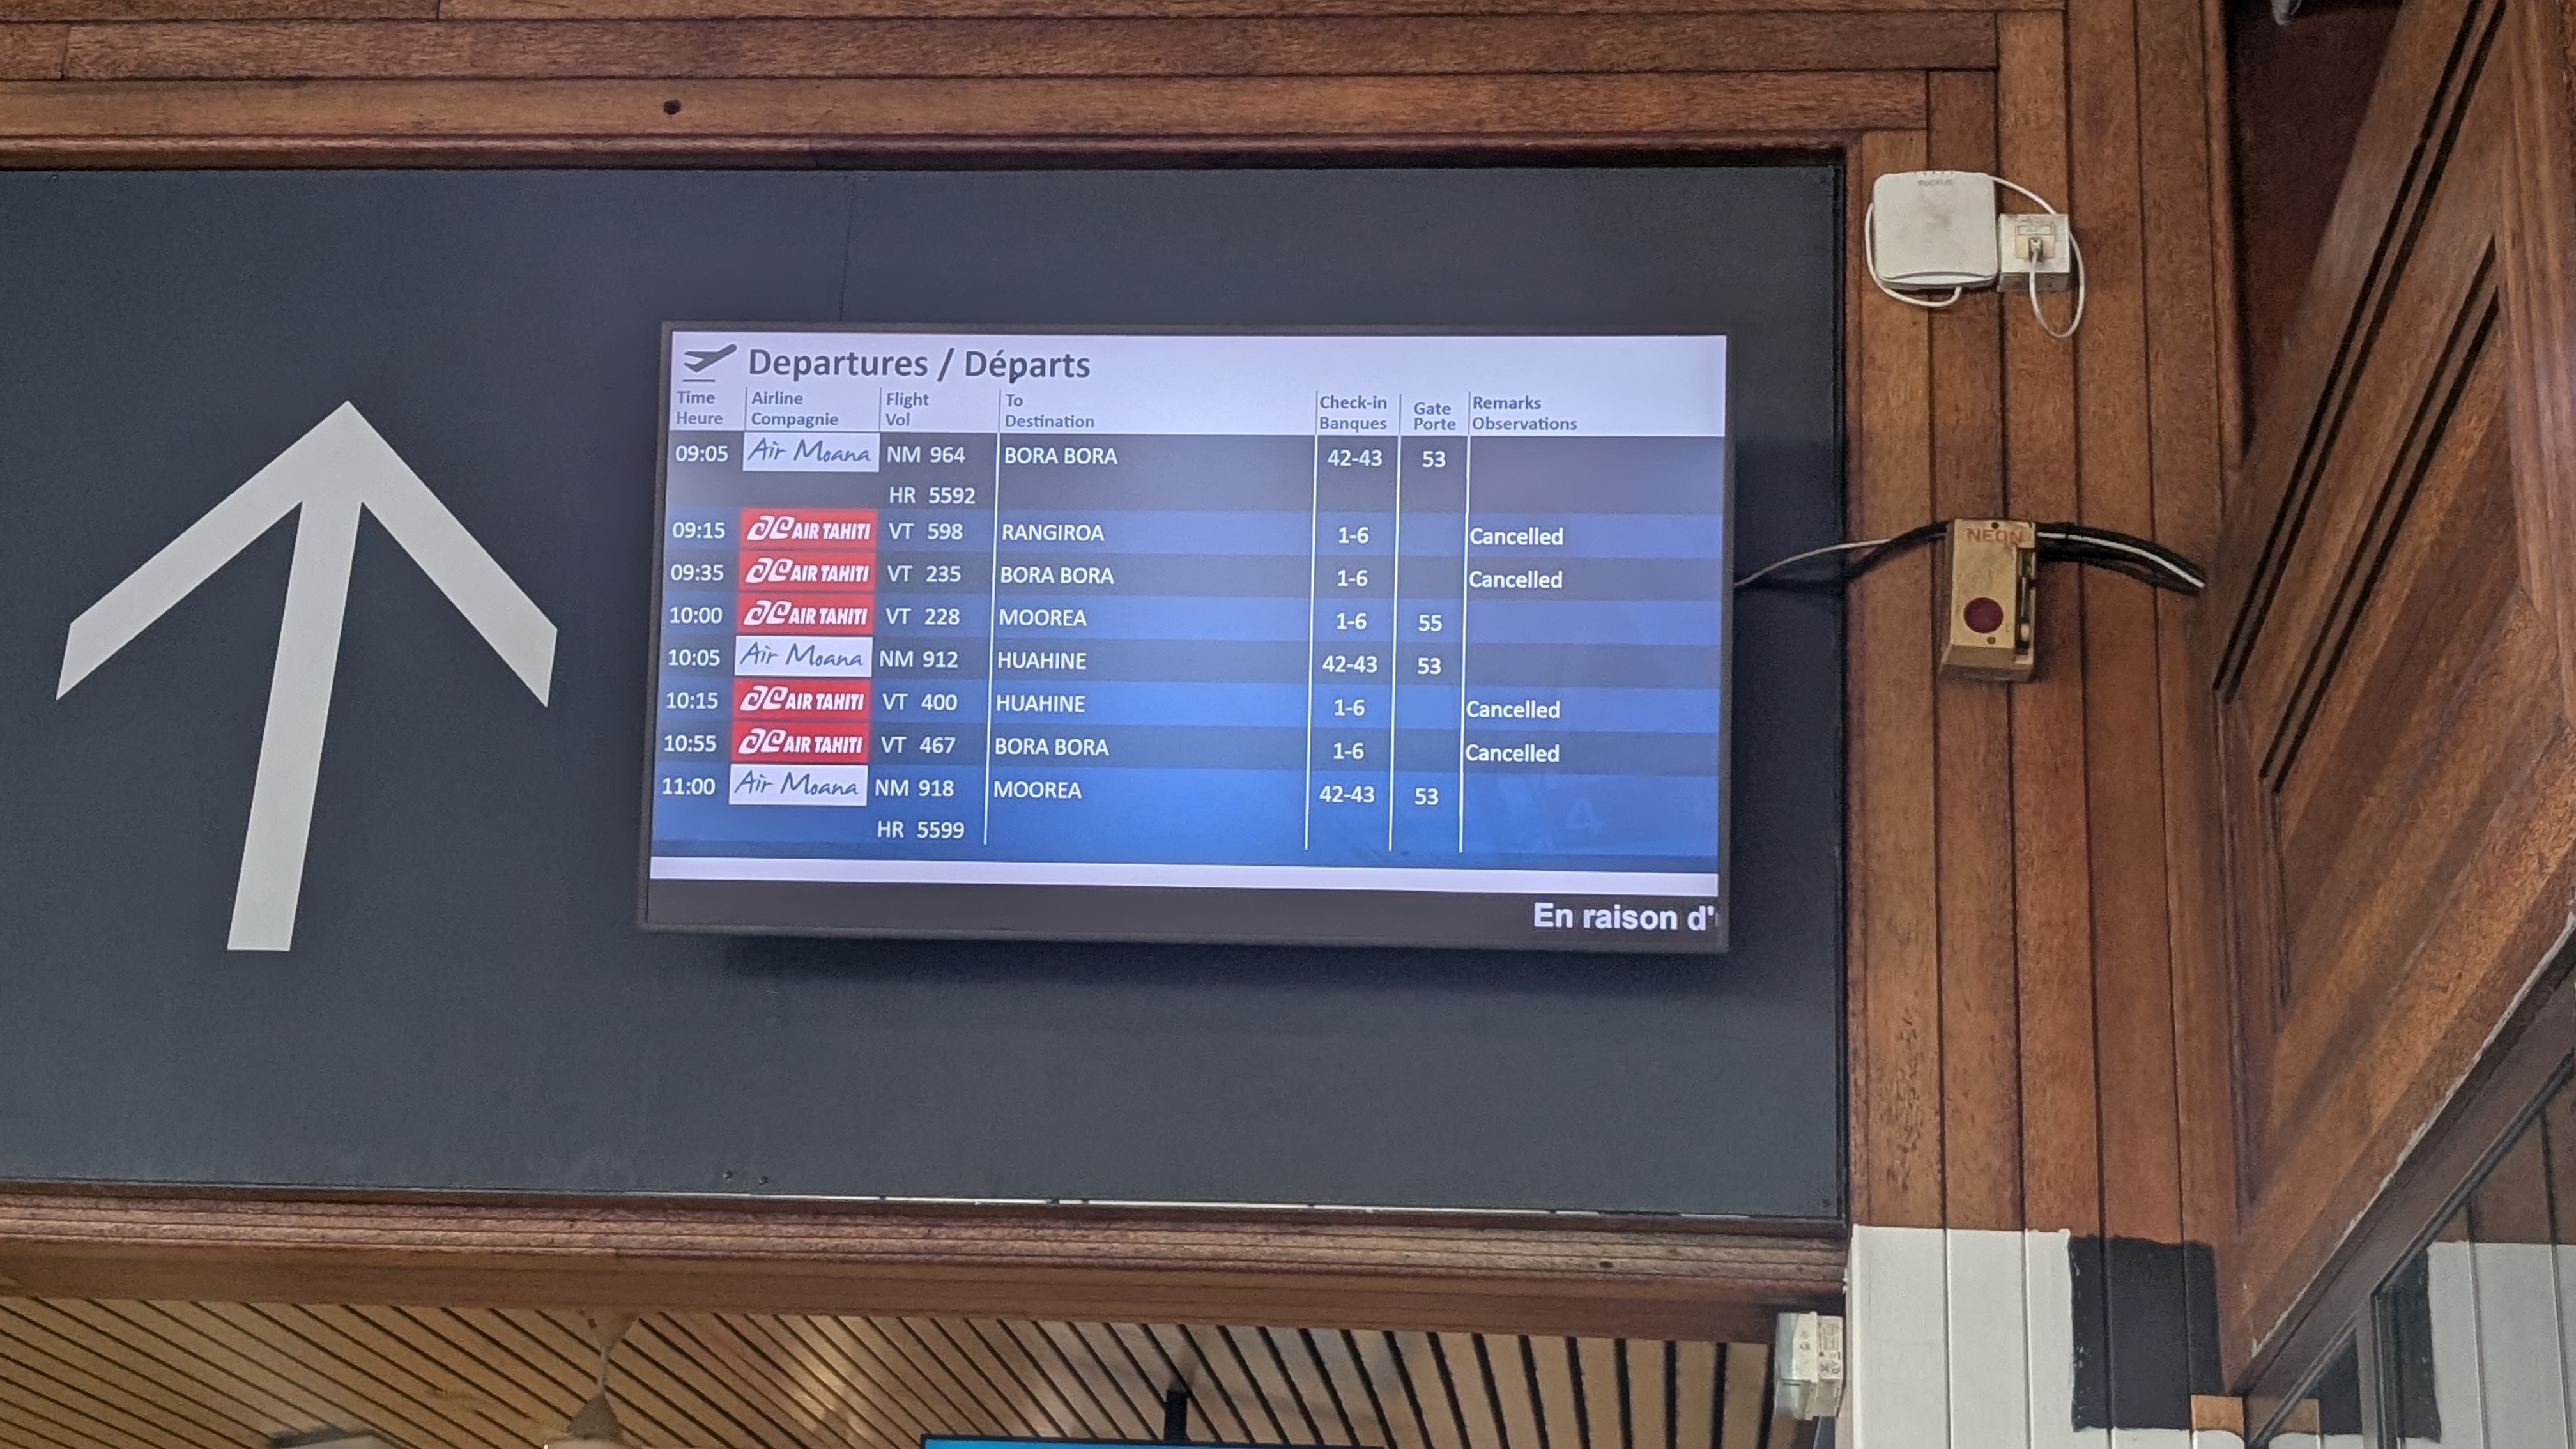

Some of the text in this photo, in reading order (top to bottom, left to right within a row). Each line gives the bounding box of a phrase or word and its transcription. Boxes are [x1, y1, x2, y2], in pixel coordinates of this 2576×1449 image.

[750, 348, 1089, 383] Departures / Départs
[677, 391, 715, 404] Time
[752, 391, 802, 404] Airline
[887, 392, 928, 408] Flight
[1006, 394, 1023, 406] To
[1320, 395, 1386, 409] Check-in
[1474, 395, 1541, 409] Remarks
[1414, 402, 1451, 415] Gate
[677, 411, 723, 424] Heure
[752, 413, 838, 428] Compagnie
[886, 413, 910, 425] Vol
[1006, 415, 1094, 427] Destination
[1320, 417, 1386, 433] Banques
[1414, 418, 1456, 430] Porte
[1473, 417, 1577, 430] Observations
[676, 446, 728, 461] 09:05
[748, 438, 870, 462] Air Moana
[887, 446, 965, 463] NM 964
[1006, 447, 1117, 464] BORA BORA
[1328, 450, 1382, 466] 42-43
[1423, 451, 1445, 467] 53
[890, 487, 975, 504] HR 5592
[673, 522, 724, 538] 09:15
[792, 523, 870, 539] AIR TAHITI
[889, 523, 962, 539] VT 598
[1003, 525, 1104, 541] RANGIROA
[1339, 527, 1368, 543] 1-6
[1470, 528, 1563, 545] Cancelled
[1966, 528, 2024, 544] NEON
[671, 564, 723, 581] 09:35
[790, 565, 869, 581] AIR TAHITI
[887, 565, 960, 582] VT 235
[1001, 567, 1114, 584] BORA BORA
[1338, 570, 1367, 586] 1-6
[1469, 571, 1562, 588] Cancelled
[671, 607, 722, 623] 10:00
[788, 608, 867, 624] AIR TAHITI
[886, 608, 960, 625] VT 228
[1000, 610, 1087, 626] MOOREA
[1337, 613, 1367, 629] 1-6
[1419, 615, 1442, 631] 55
[669, 650, 719, 666] 10:05
[740, 642, 862, 666] Air Moana
[880, 650, 958, 668] NM 912
[999, 652, 1086, 669] HUAHINE
[1322, 656, 1377, 673] 42-43
[1418, 658, 1441, 674] 53
[667, 693, 717, 709] 10:15
[785, 693, 864, 710] AIR TAHITI
[883, 694, 957, 710] VT 400
[997, 695, 1085, 712] HUAHINE
[1335, 700, 1365, 716] 1-6
[1467, 700, 1560, 718] Cancelled
[664, 735, 716, 751] 10:55
[783, 737, 862, 753] AIR TAHITI
[882, 737, 955, 753] VT 467
[996, 738, 1109, 755] BORA BORA
[1334, 743, 1363, 759] 1-6
[1466, 744, 1559, 762] Cancelled
[663, 778, 715, 795] 11:00
[735, 770, 857, 795] Air Moana
[875, 779, 954, 796] NM 918
[995, 781, 1082, 798] MOOREA
[1320, 786, 1374, 802] 42-43
[1415, 788, 1438, 804] 53
[878, 821, 964, 838] HR 5599
[1535, 903, 1572, 928] En
[1584, 904, 1677, 930] raison
